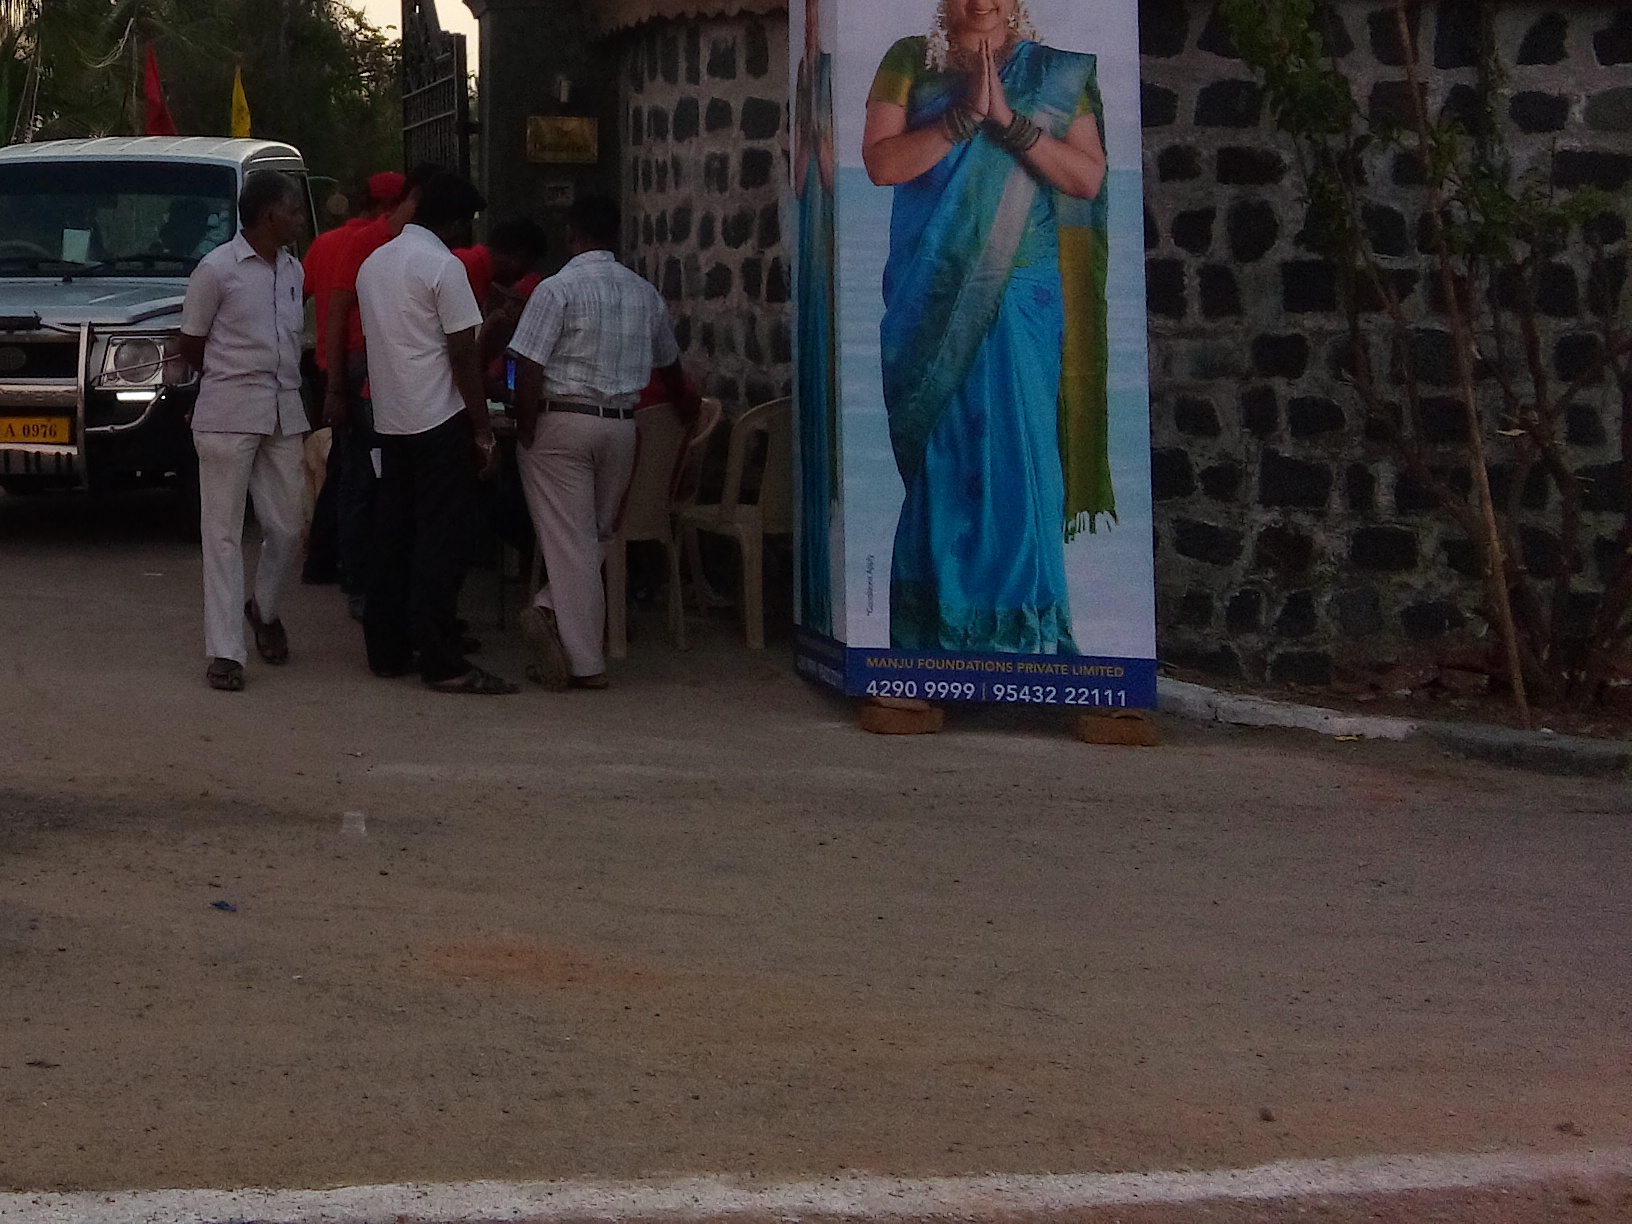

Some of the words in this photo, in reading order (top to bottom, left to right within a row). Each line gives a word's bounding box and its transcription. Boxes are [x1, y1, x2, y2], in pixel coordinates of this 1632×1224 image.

[5, 424, 16, 437] A
[867, 657, 914, 669] MANJU
[918, 659, 1013, 673] FOUNDATIONS
[1017, 662, 1068, 675] PRIVATE
[1072, 665, 1124, 677] LIMITED
[866, 680, 917, 698] 4290
[924, 681, 975, 700] 9999
[992, 683, 1057, 704] 95432
[1064, 687, 1126, 707] 22111
